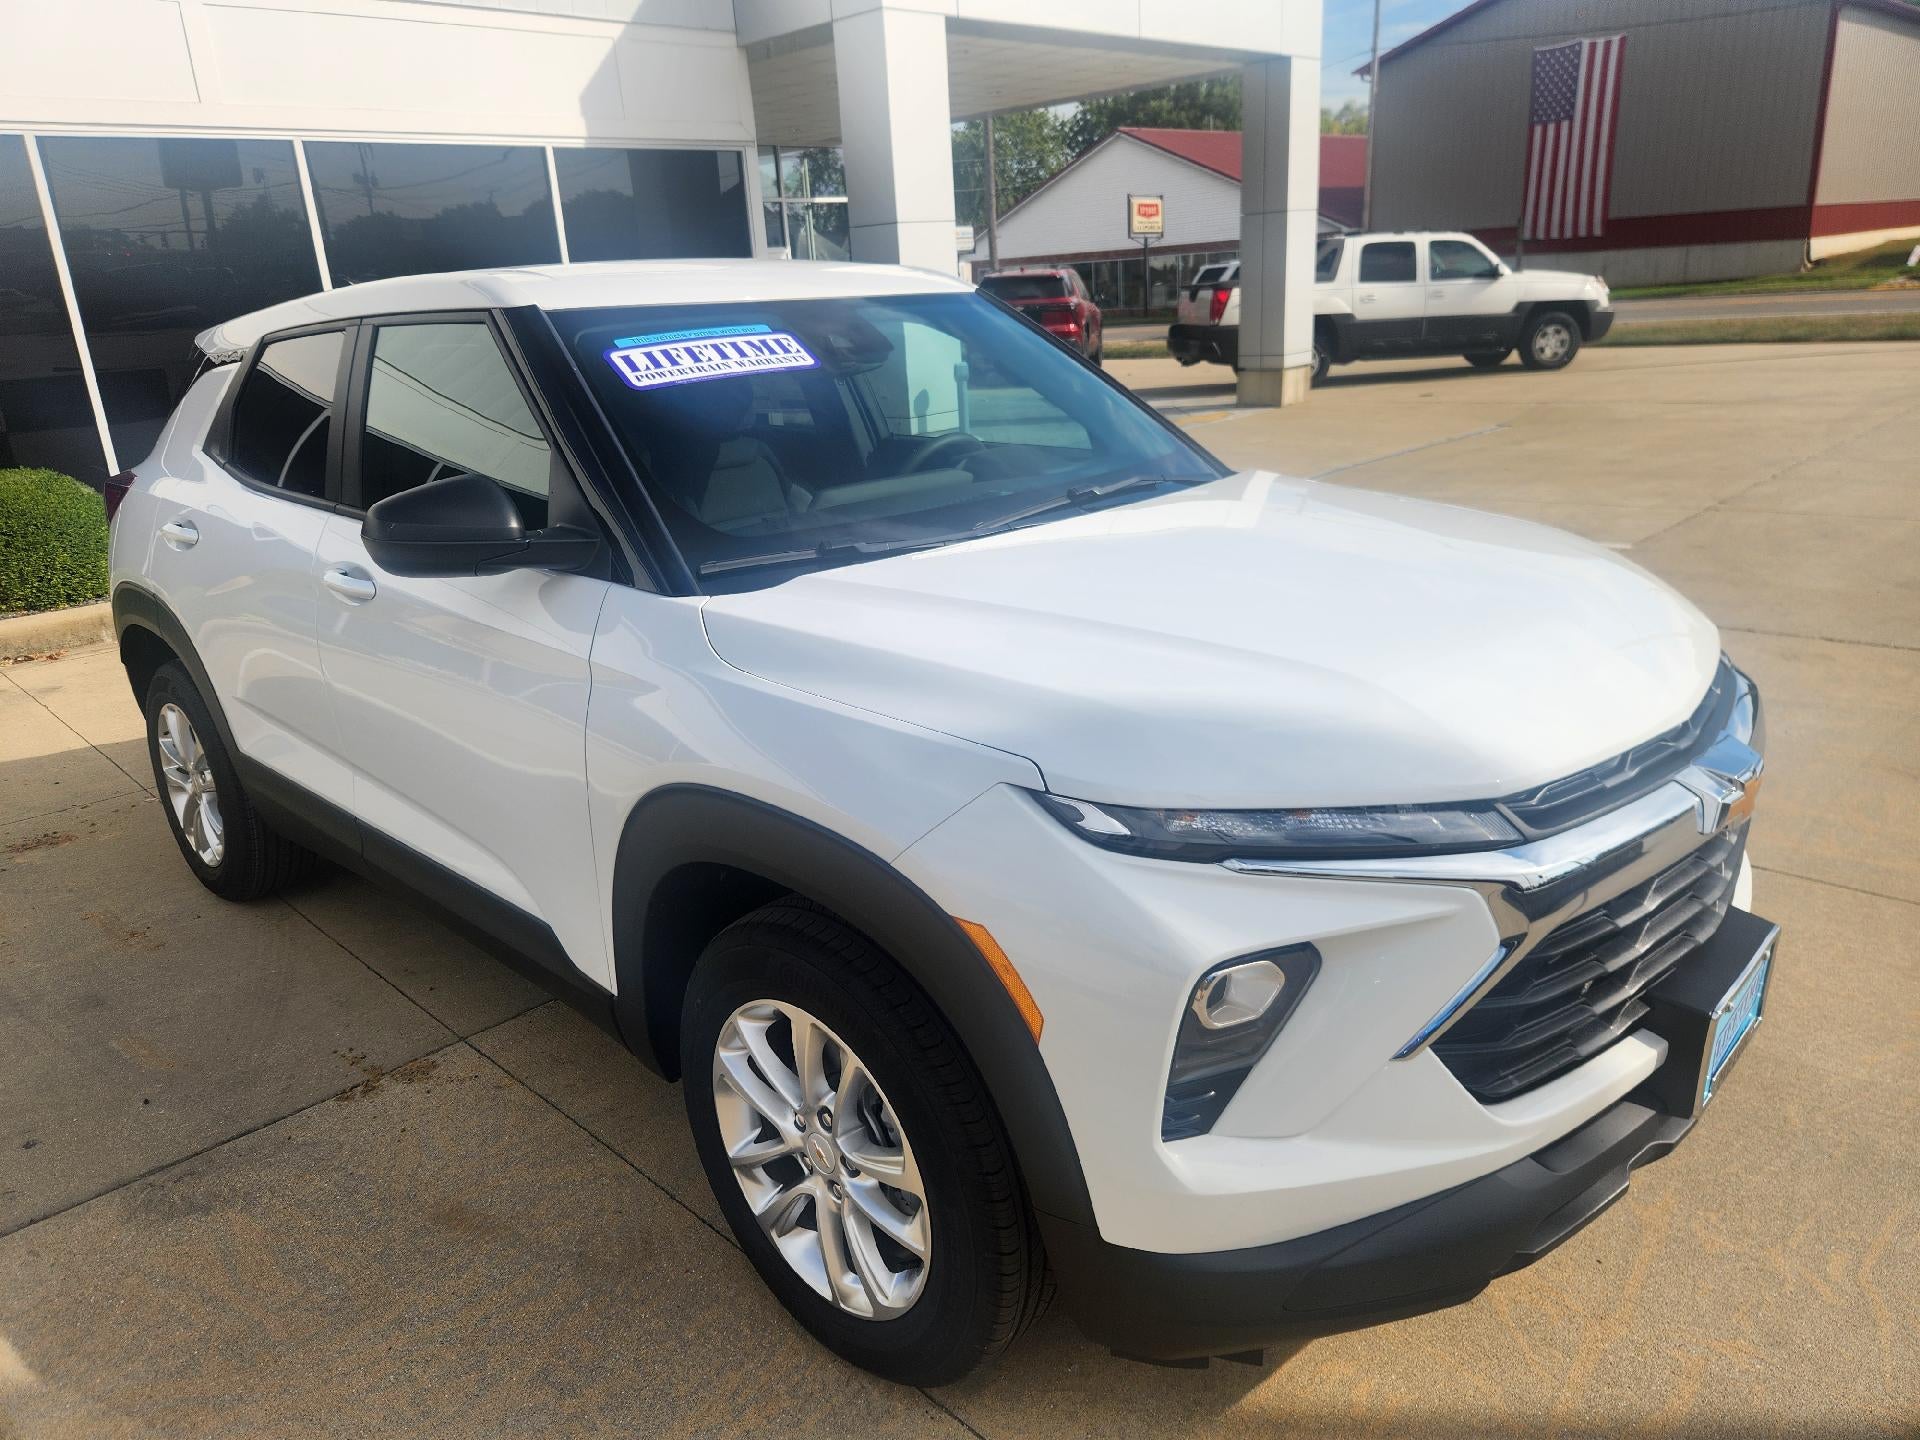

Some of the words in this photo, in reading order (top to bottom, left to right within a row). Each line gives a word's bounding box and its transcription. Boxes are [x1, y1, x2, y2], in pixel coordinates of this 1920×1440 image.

[618, 337, 802, 373] LIFETIME
[635, 361, 732, 383] POWERTRAIN
[733, 354, 809, 369] WARRANTY
